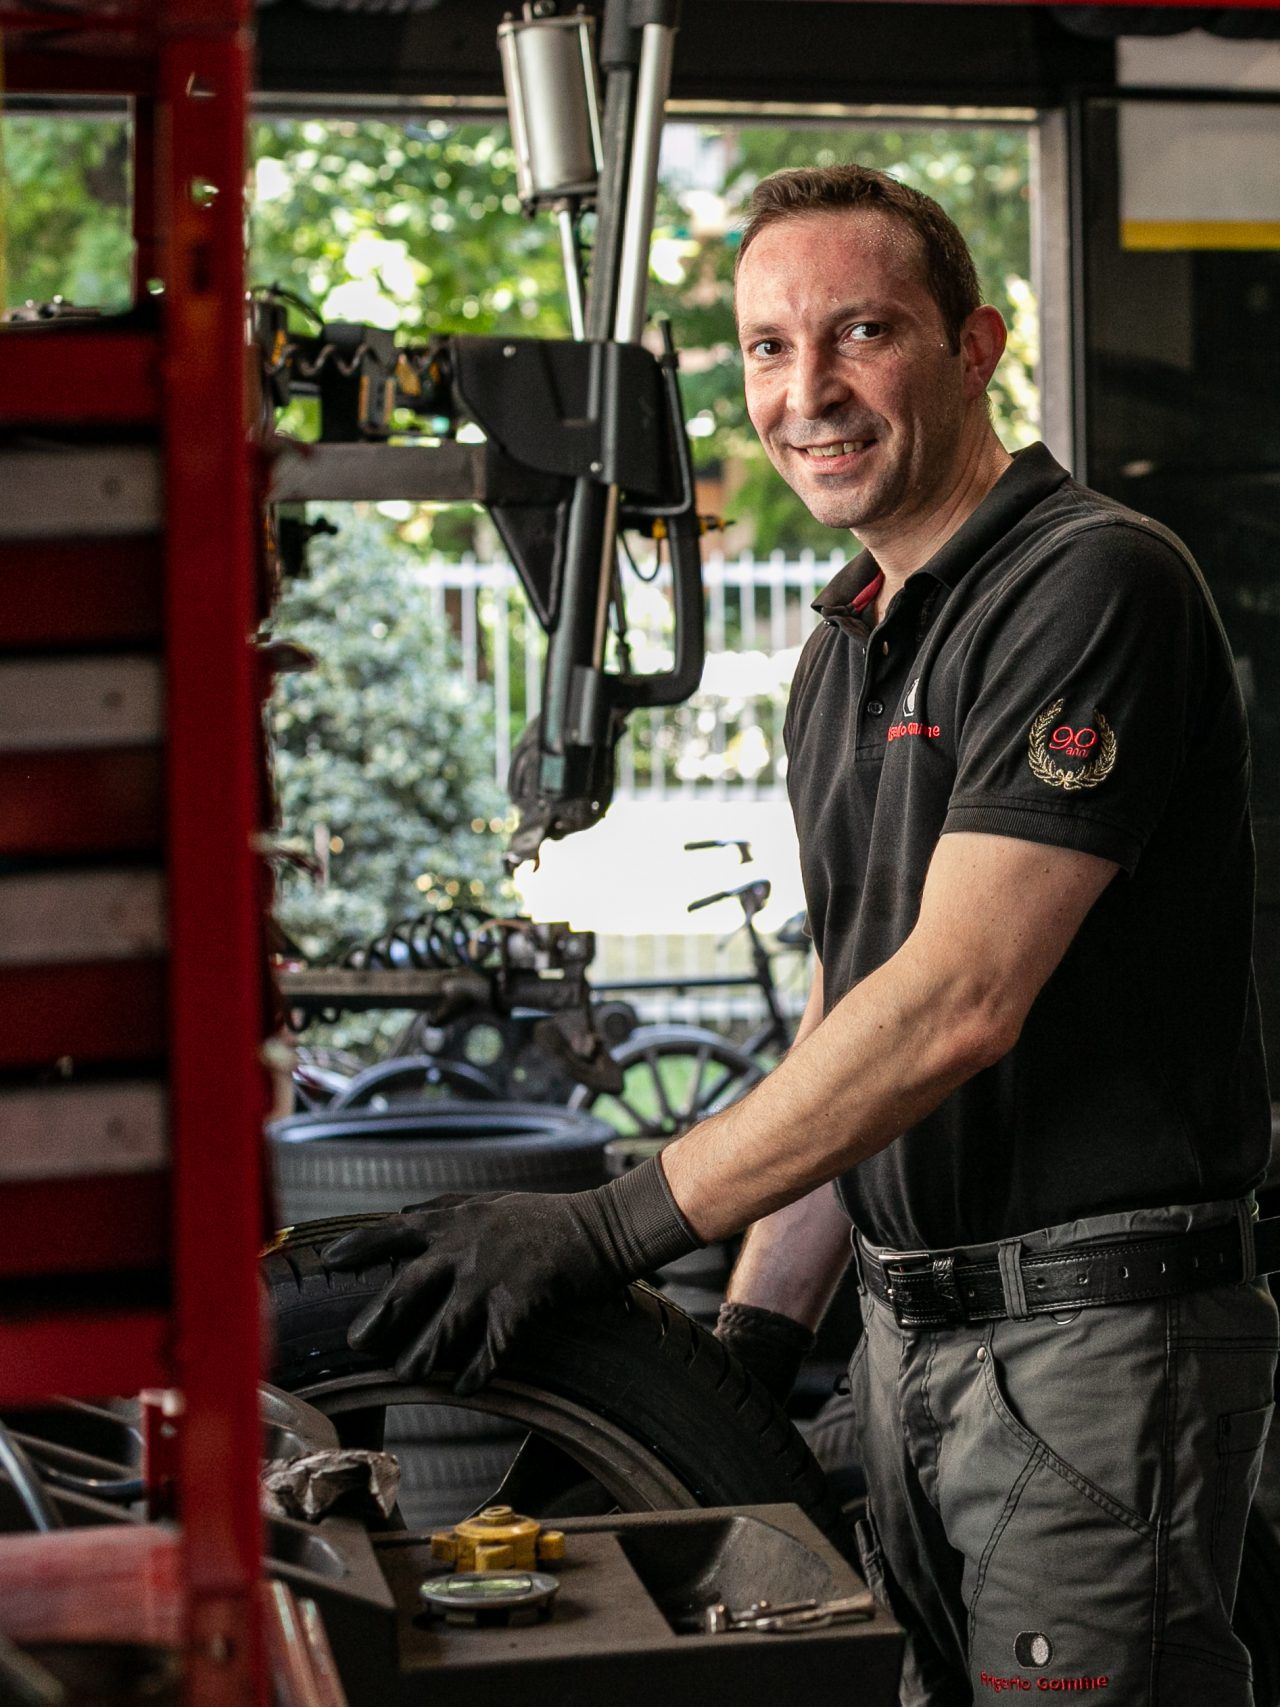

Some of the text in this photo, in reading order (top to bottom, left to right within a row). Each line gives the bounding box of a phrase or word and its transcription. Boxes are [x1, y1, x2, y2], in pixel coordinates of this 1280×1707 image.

[1049, 726, 1098, 750] 90
[1065, 746, 1090, 758] anni
[981, 1671, 1108, 1692] Frigerio Gomme
